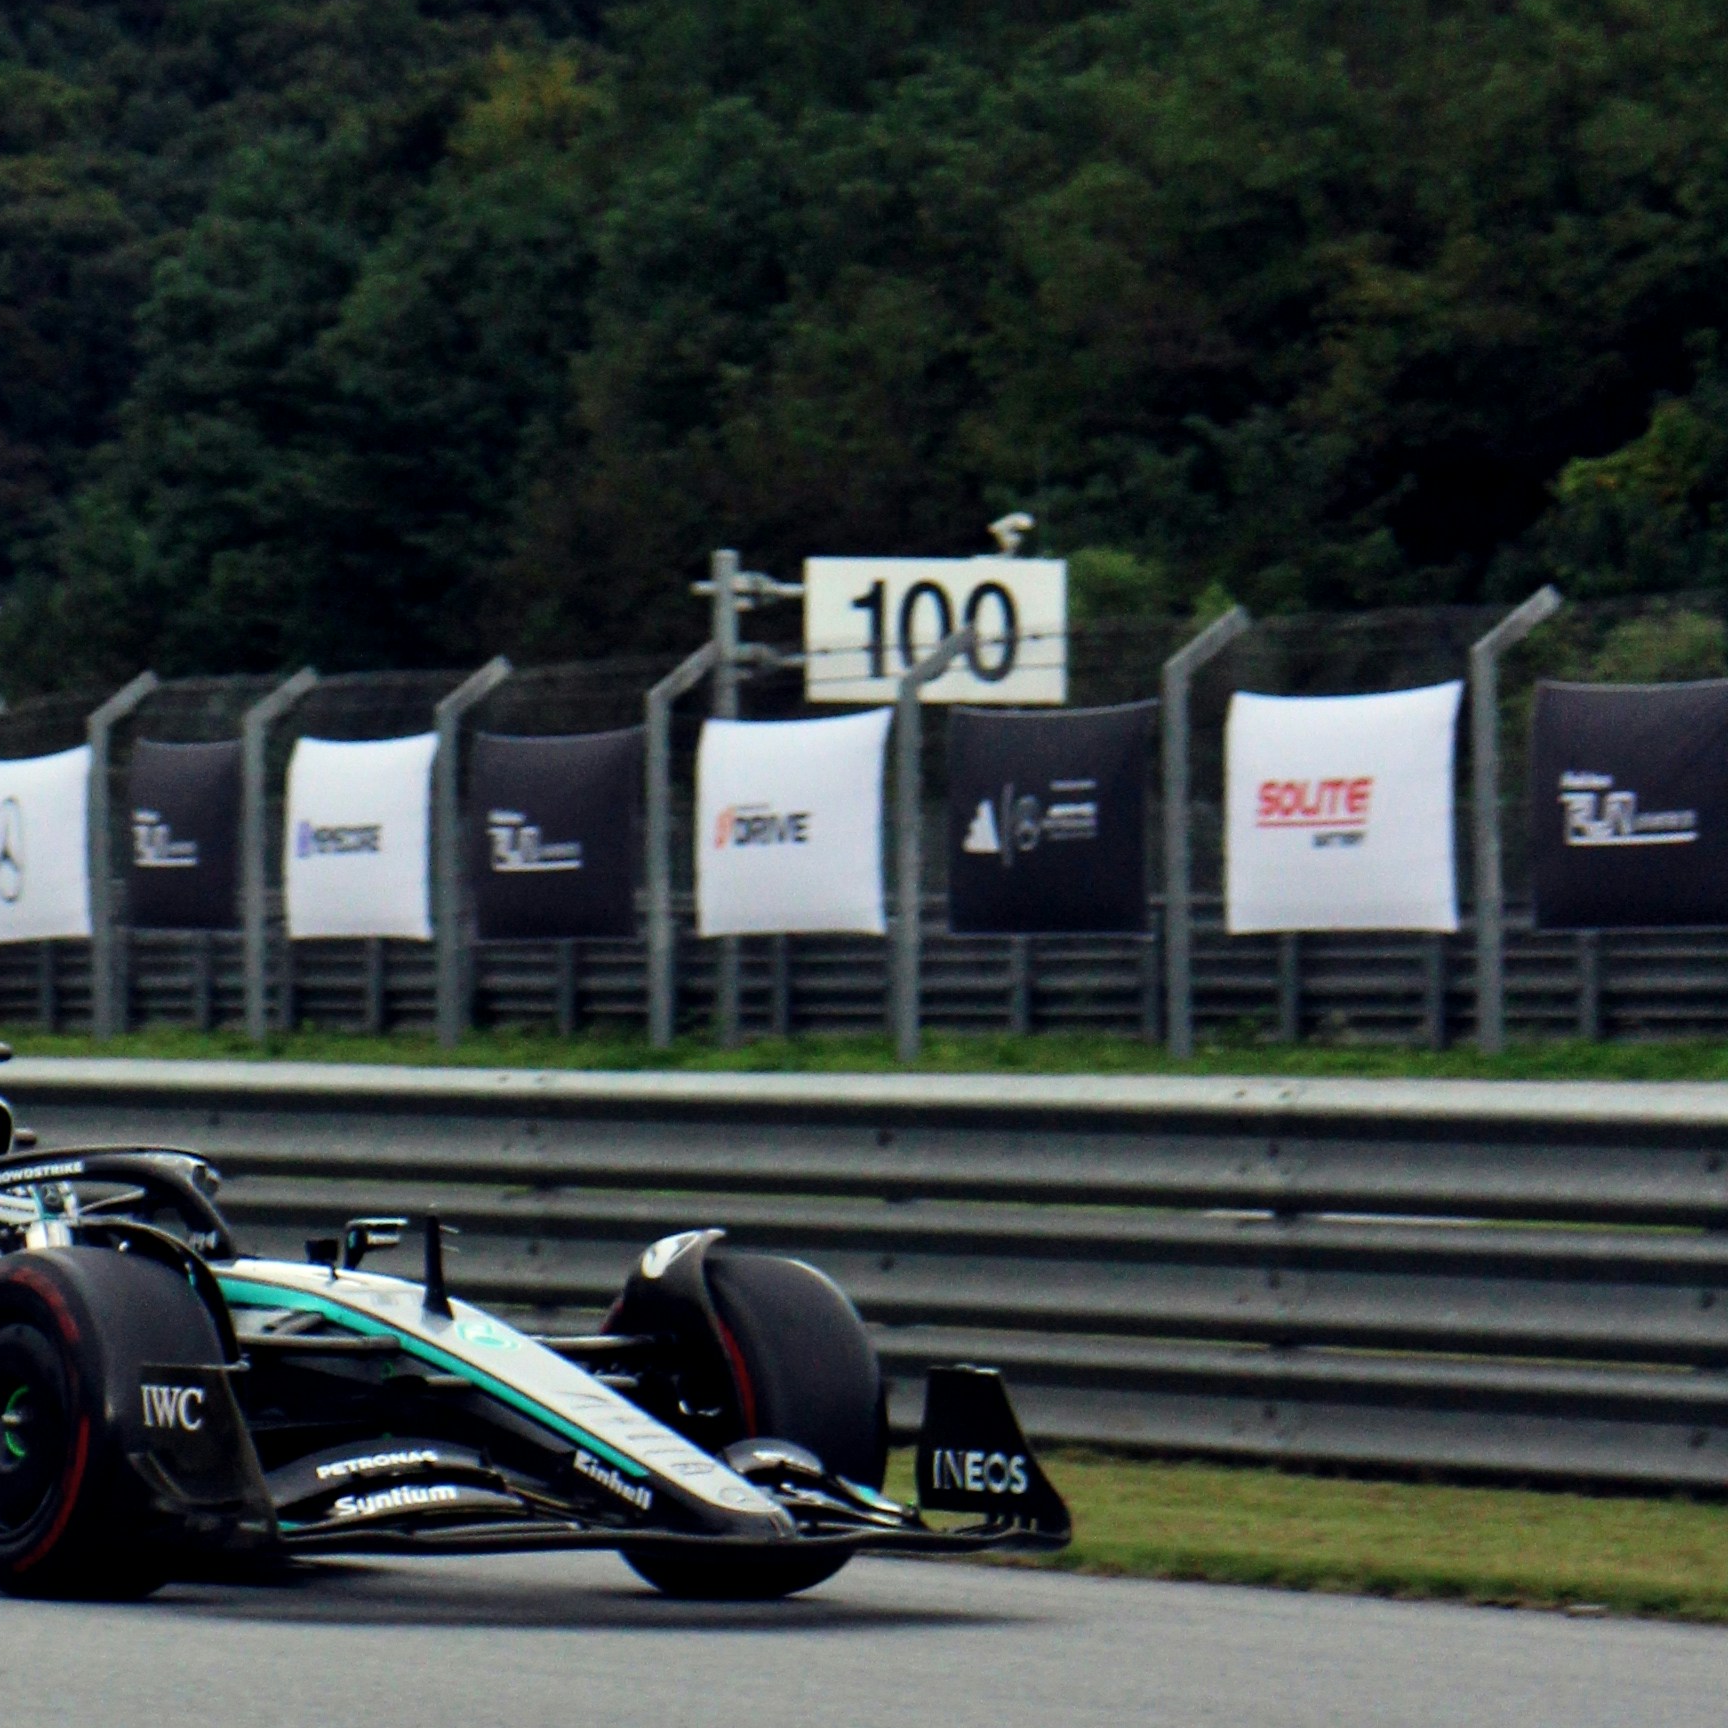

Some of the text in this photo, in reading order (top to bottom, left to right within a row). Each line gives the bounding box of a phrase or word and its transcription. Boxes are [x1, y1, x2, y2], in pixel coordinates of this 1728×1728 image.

[852, 580, 1018, 683] 100
[140, 1384, 205, 1431] IWC
[316, 1450, 439, 1480] PETRONAS
[573, 1449, 653, 1512] Einhell
[932, 1449, 1030, 1495] INEOS
[332, 1484, 459, 1519] Syntium
